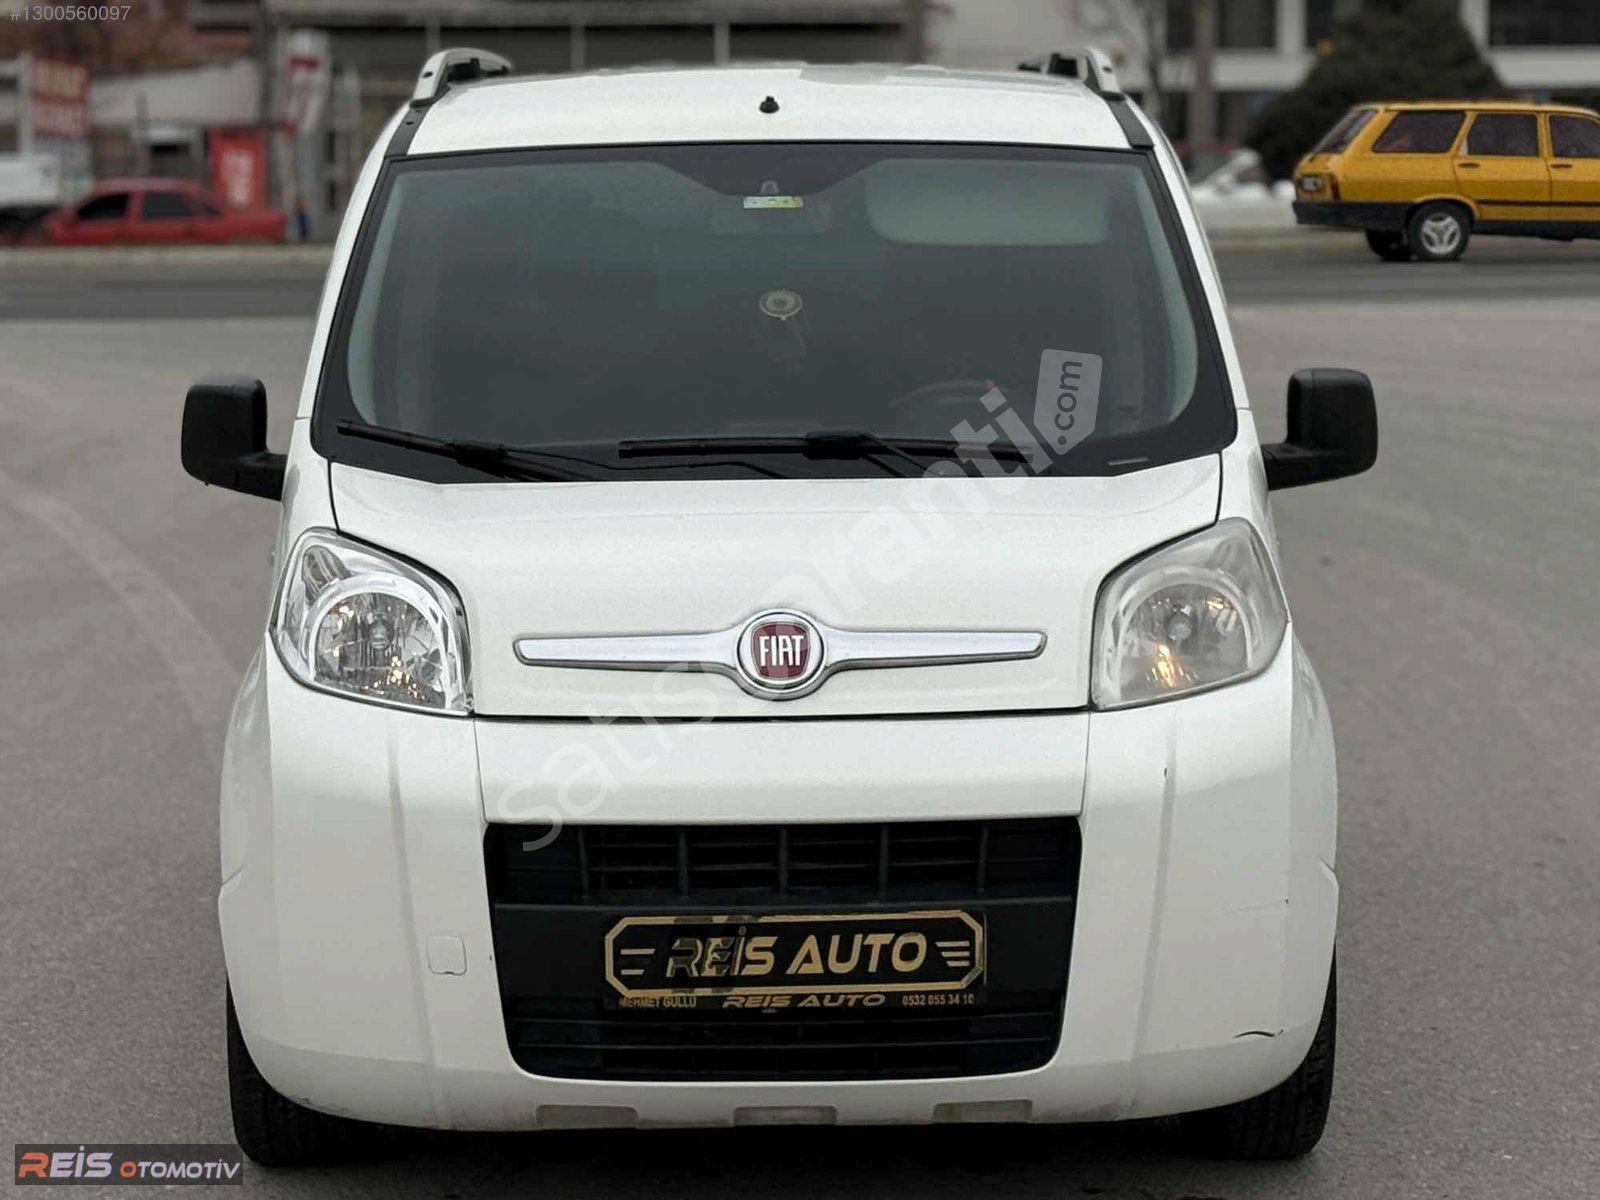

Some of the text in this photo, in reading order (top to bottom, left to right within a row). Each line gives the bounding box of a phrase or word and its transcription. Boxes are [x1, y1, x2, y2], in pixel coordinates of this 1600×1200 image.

[760, 635, 804, 667] FIAT
[786, 932, 926, 975] AUTO
[797, 993, 886, 1007] AUTO
